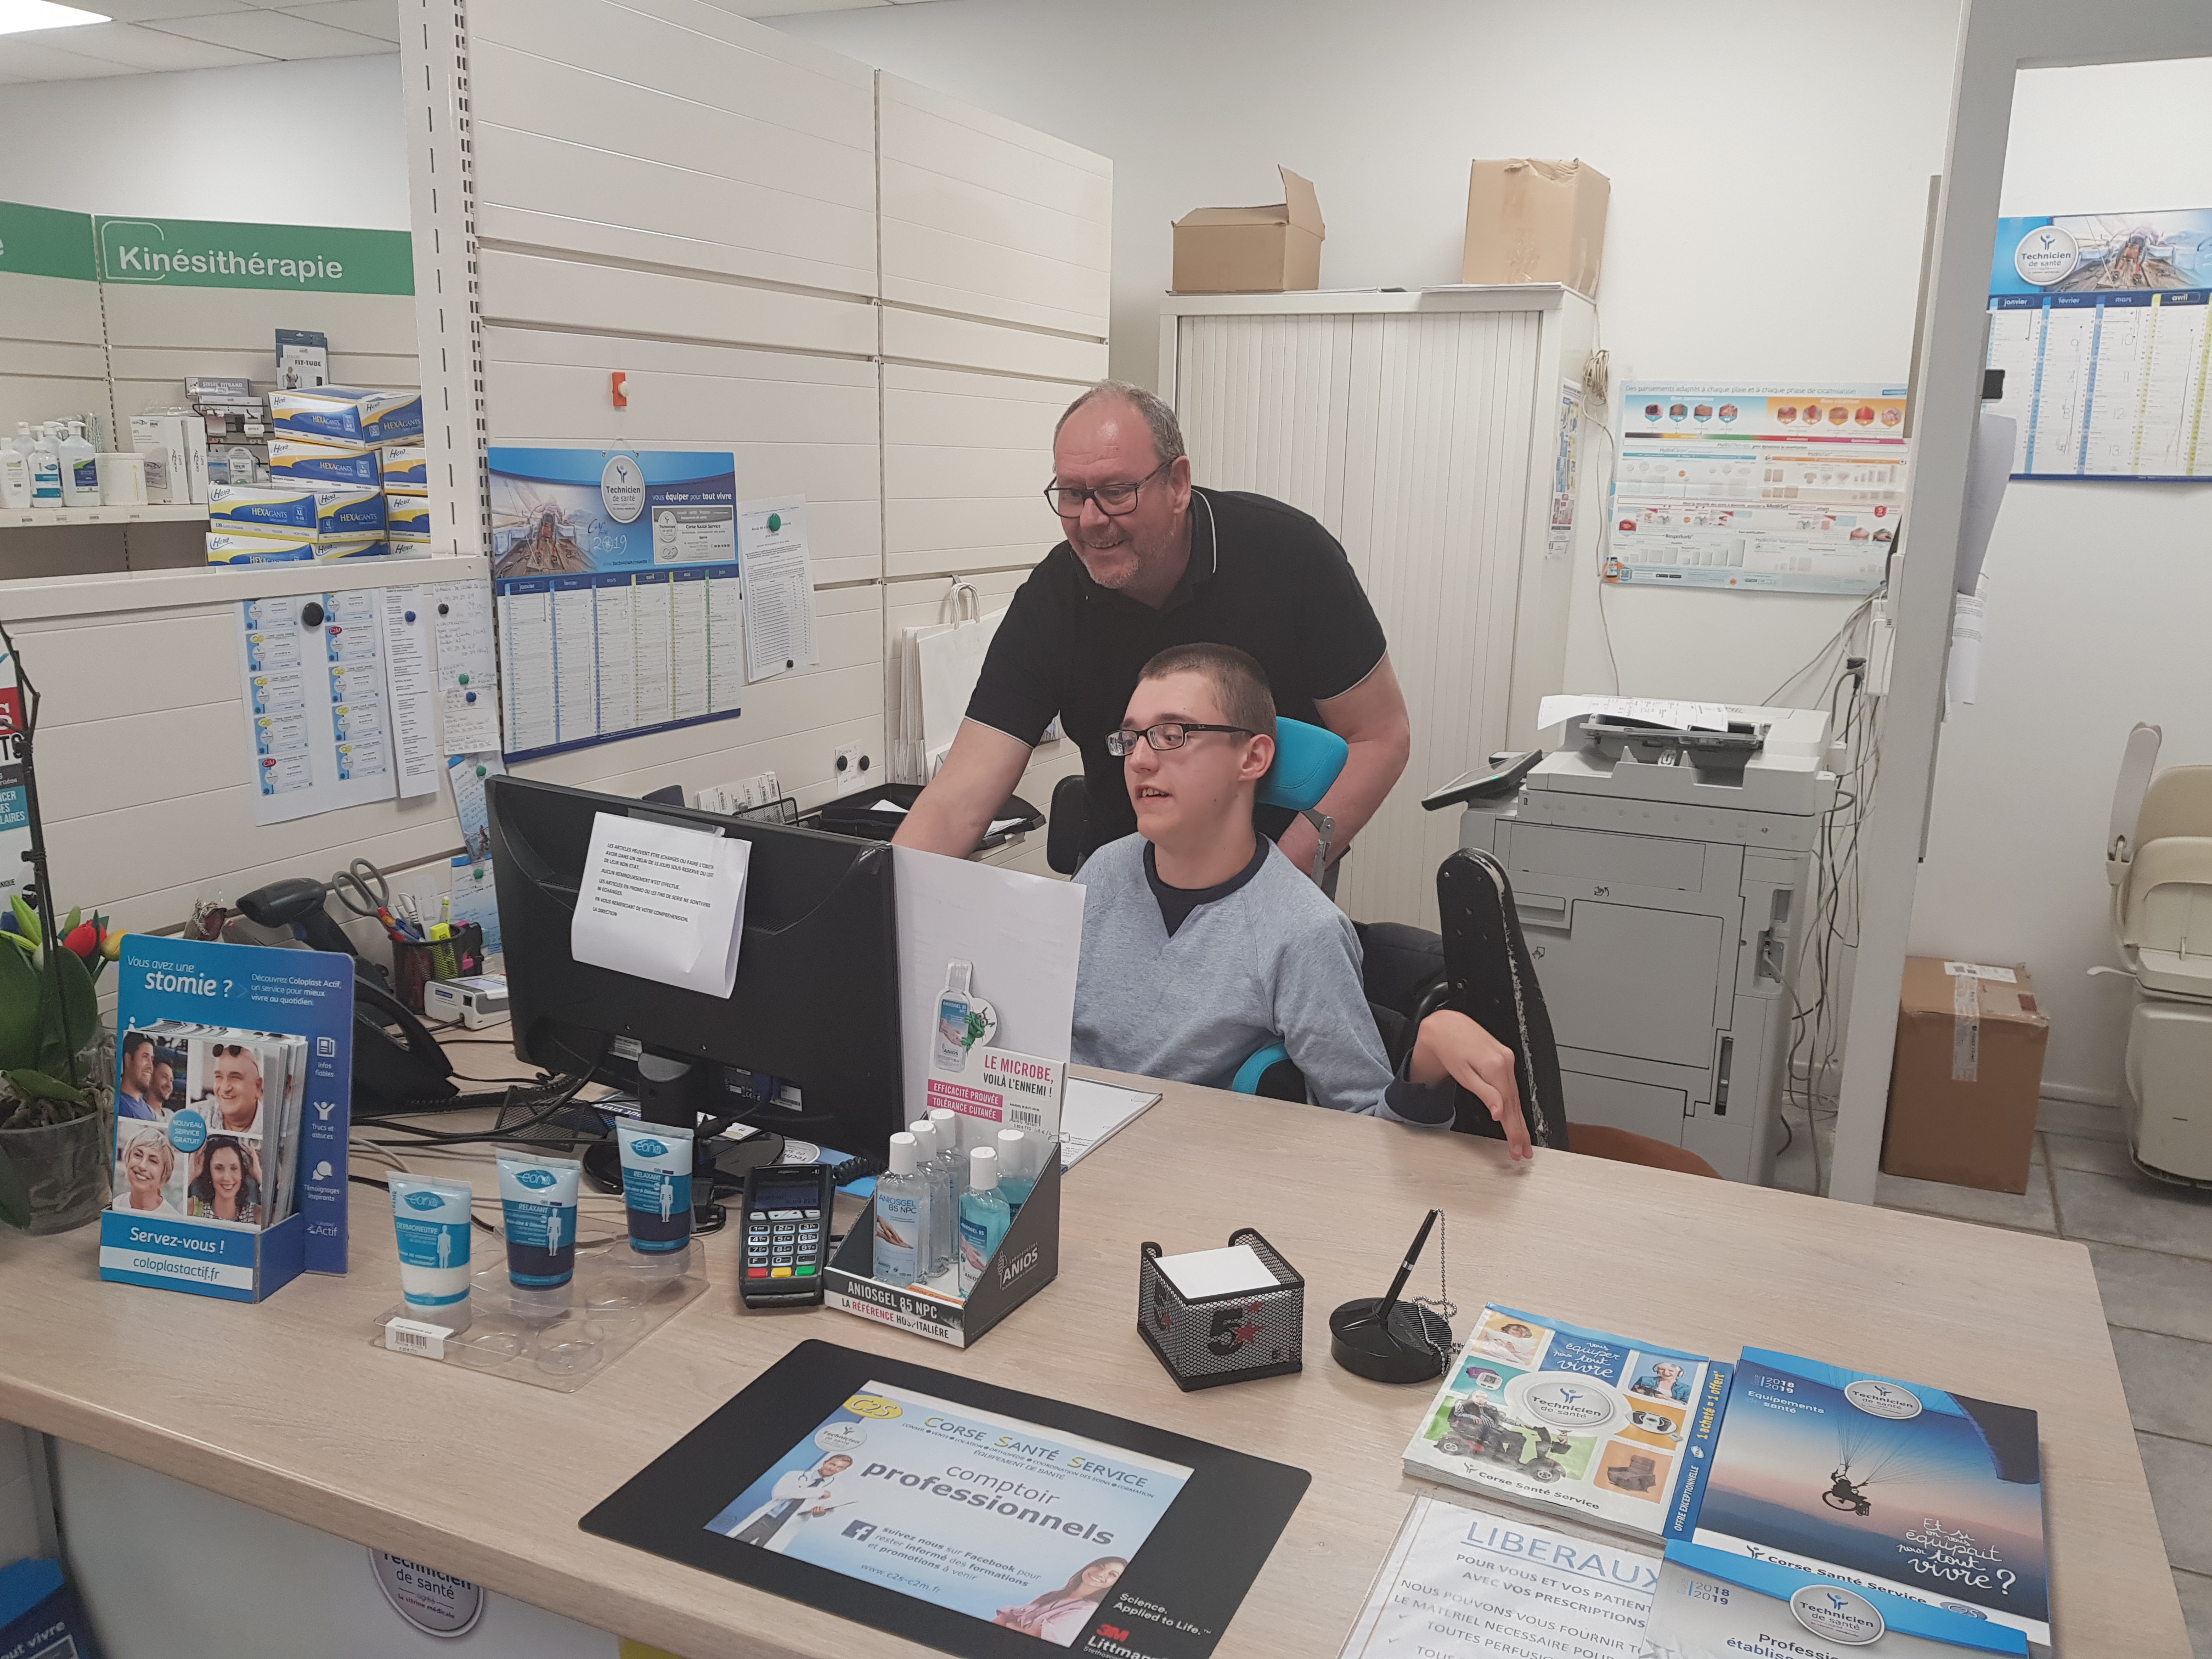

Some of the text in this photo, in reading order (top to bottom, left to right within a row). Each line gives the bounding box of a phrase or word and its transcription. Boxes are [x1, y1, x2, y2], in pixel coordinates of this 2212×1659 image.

[119, 246, 342, 283] Kinésithérapie
[2022, 251, 2071, 260] Technicien
[2172, 294, 2187, 302] avril
[665, 492, 689, 502] équiper
[251, 507, 287, 518] HEXAGANTS
[340, 513, 377, 522] HEXAGANTS
[127, 956, 194, 973] Vous avez une
[145, 971, 233, 998] stomie ?
[252, 974, 341, 989] Découvrez Coloplast Actif,
[280, 996, 314, 1006] quotidien.
[985, 1054, 1053, 1084] LE MICROBE,
[934, 1081, 998, 1104] EFFICACITÉ PROUVÉE
[984, 1073, 1046, 1096] VOILÀ L'ENNEMI
[933, 1096, 967, 1114] TOLÉRANCE
[969, 1106, 996, 1119] CUTANÉE
[173, 1120, 202, 1129] NOUVEAU
[175, 1128, 199, 1137] SERVICE
[312, 1124, 328, 1132] Trucs
[174, 1136, 200, 1144] GRATUIT
[304, 1184, 339, 1195] Témoignages
[308, 1193, 335, 1201] inspirants
[879, 1194, 916, 1207] ANIOSGEL
[518, 1204, 548, 1214] RELAXANT
[888, 1204, 917, 1214] 85 NPC
[396, 1222, 438, 1234] DERMONEUTRE
[129, 1227, 216, 1254] Servez-vous
[133, 1257, 219, 1282] coloplastactif.fr
[1002, 1247, 1038, 1284] ANIOS
[848, 1282, 937, 1318] ANIOSGEL 85 NPC
[842, 1298, 949, 1339] LA RÉFÉRENCE HOSPITALIÈRE
[1764, 1383, 1794, 1395] 2019
[1766, 1376, 1795, 1389] 2018
[851, 1400, 898, 1417] C2S
[1532, 1396, 1601, 1418] Technicien
[1540, 1405, 1587, 1419] de santé
[1748, 1390, 1825, 1414] Equipements
[1764, 1401, 1797, 1414] santé
[924, 1417, 1148, 1488] CORSE SANTÉ SERVICE
[973, 1449, 1025, 1470] ÉQUIPEMENT
[1038, 1468, 1066, 1481] SANTÉ
[946, 1466, 1059, 1505] comptoir
[1479, 1471, 1599, 1510] Corse Santé Service
[860, 1463, 1114, 1545] professionnels
[1674, 1465, 1699, 1532] OFFRE EXCEPTIONNELLE
[1923, 1518, 1975, 1542] Et si
[883, 1527, 1042, 1581] suivez nous sur Facebook pour
[1906, 1529, 2002, 1561] équipait
[876, 1534, 1029, 1587] rester informé des formations
[879, 1546, 940, 1570] promotions
[942, 1562, 949, 1573] à
[952, 1570, 978, 1581] venir
[1896, 1544, 1987, 1571] pour tout
[396, 1569, 454, 1600] de santé
[861, 1564, 941, 1593] www.c2s-c2m.fr
[1457, 1553, 1495, 1571] POUR
[1498, 1564, 1538, 1582] VOUS
[1542, 1577, 1559, 1587] ET
[1561, 1583, 1590, 1597] VOS
[1768, 1556, 1927, 1604] Corse Santé Service
[1908, 1559, 2016, 1595] vivre ?
[1120, 1593, 1168, 1615] Science.
[1462, 1572, 1646, 1629] AVEC VOS PRESCRIPTIONS
[1113, 1601, 1160, 1623] Applied
[1161, 1616, 1174, 1626] to
[1394, 1595, 1570, 1652] LE MATERIEL NECESSAIRE
[1401, 1580, 1624, 1650] NOUS POUVONS VOUS FOURNIR
[1097, 1623, 1130, 1642] 3M
[1427, 1622, 1481, 1644] TOUTES
